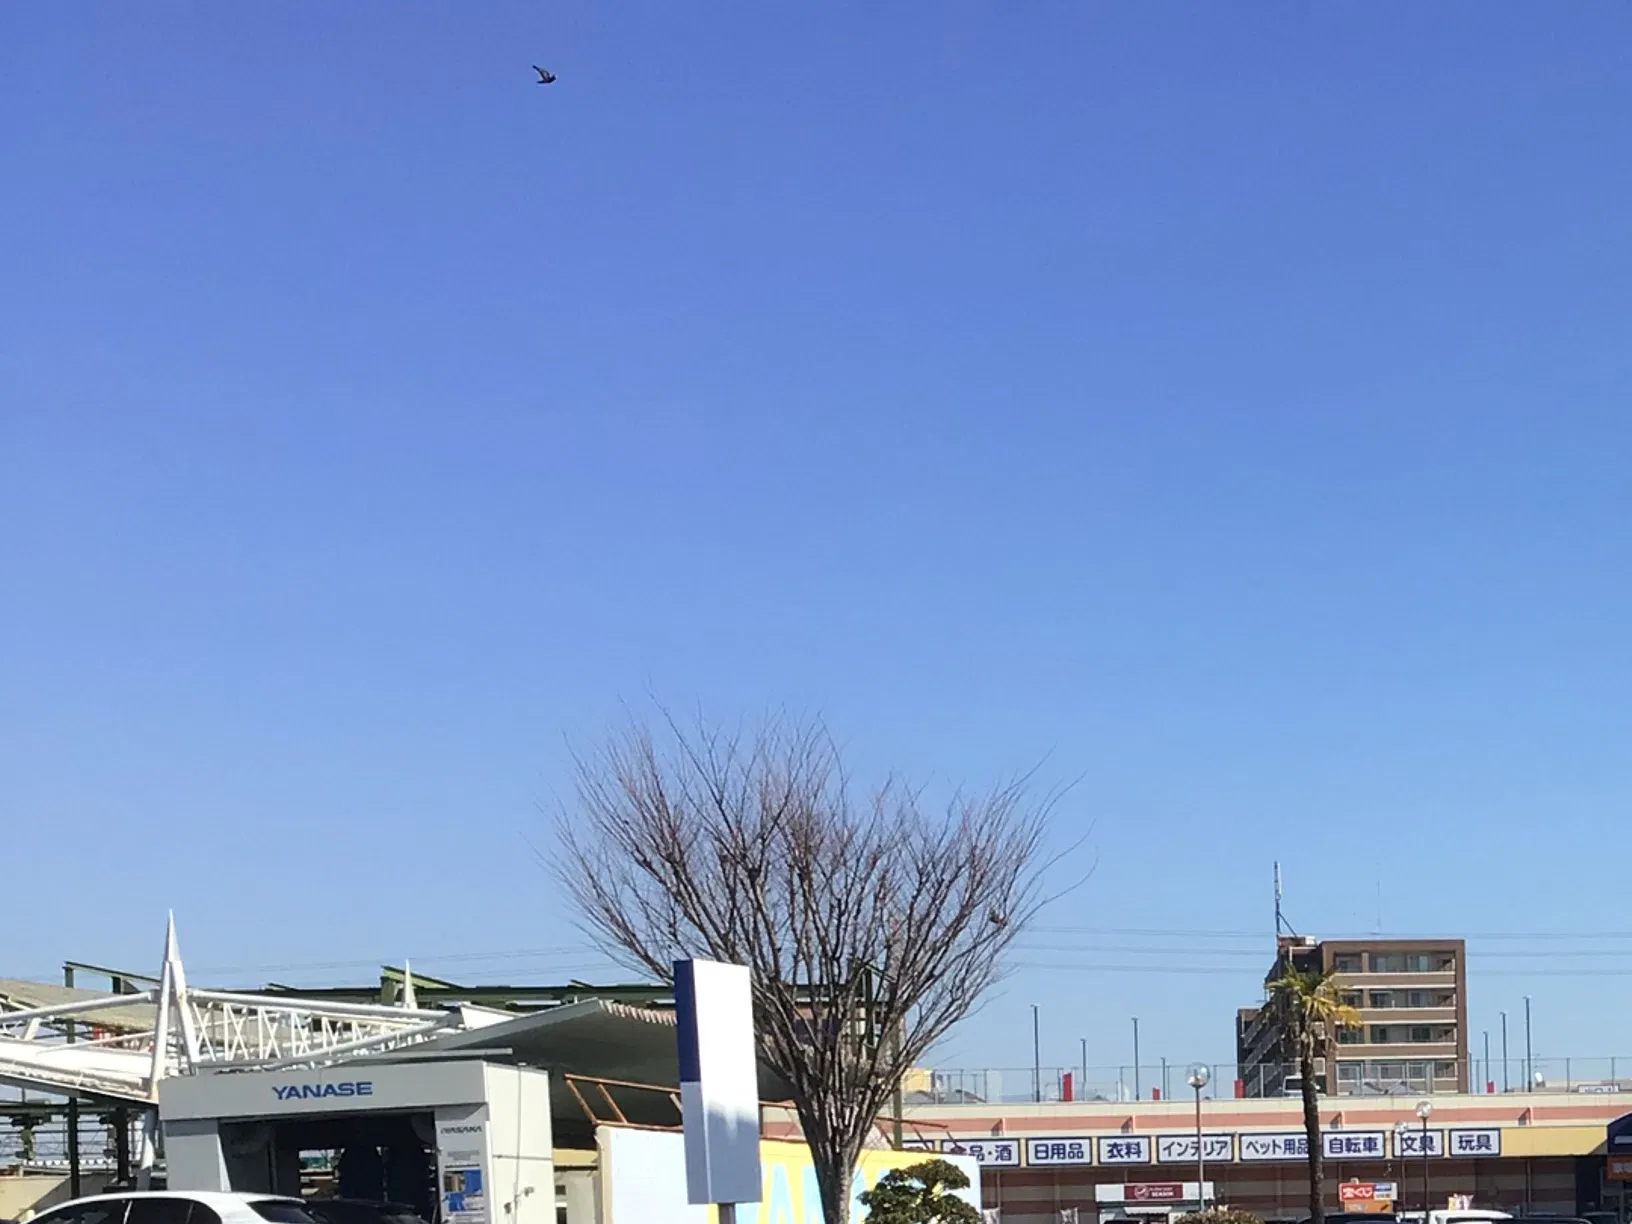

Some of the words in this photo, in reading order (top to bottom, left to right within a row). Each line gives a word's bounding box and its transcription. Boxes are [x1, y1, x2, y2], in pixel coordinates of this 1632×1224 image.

[272, 1081, 373, 1100] YANASE
[1107, 1141, 1142, 1159] 衣料
[1162, 1139, 1228, 1157] インテリア
[1246, 1138, 1309, 1156] ペット用品
[1329, 1136, 1379, 1154] 自転車
[1401, 1134, 1435, 1152] 文具
[1458, 1133, 1492, 1150] 玩具
[1034, 1143, 1084, 1160] 日用品
